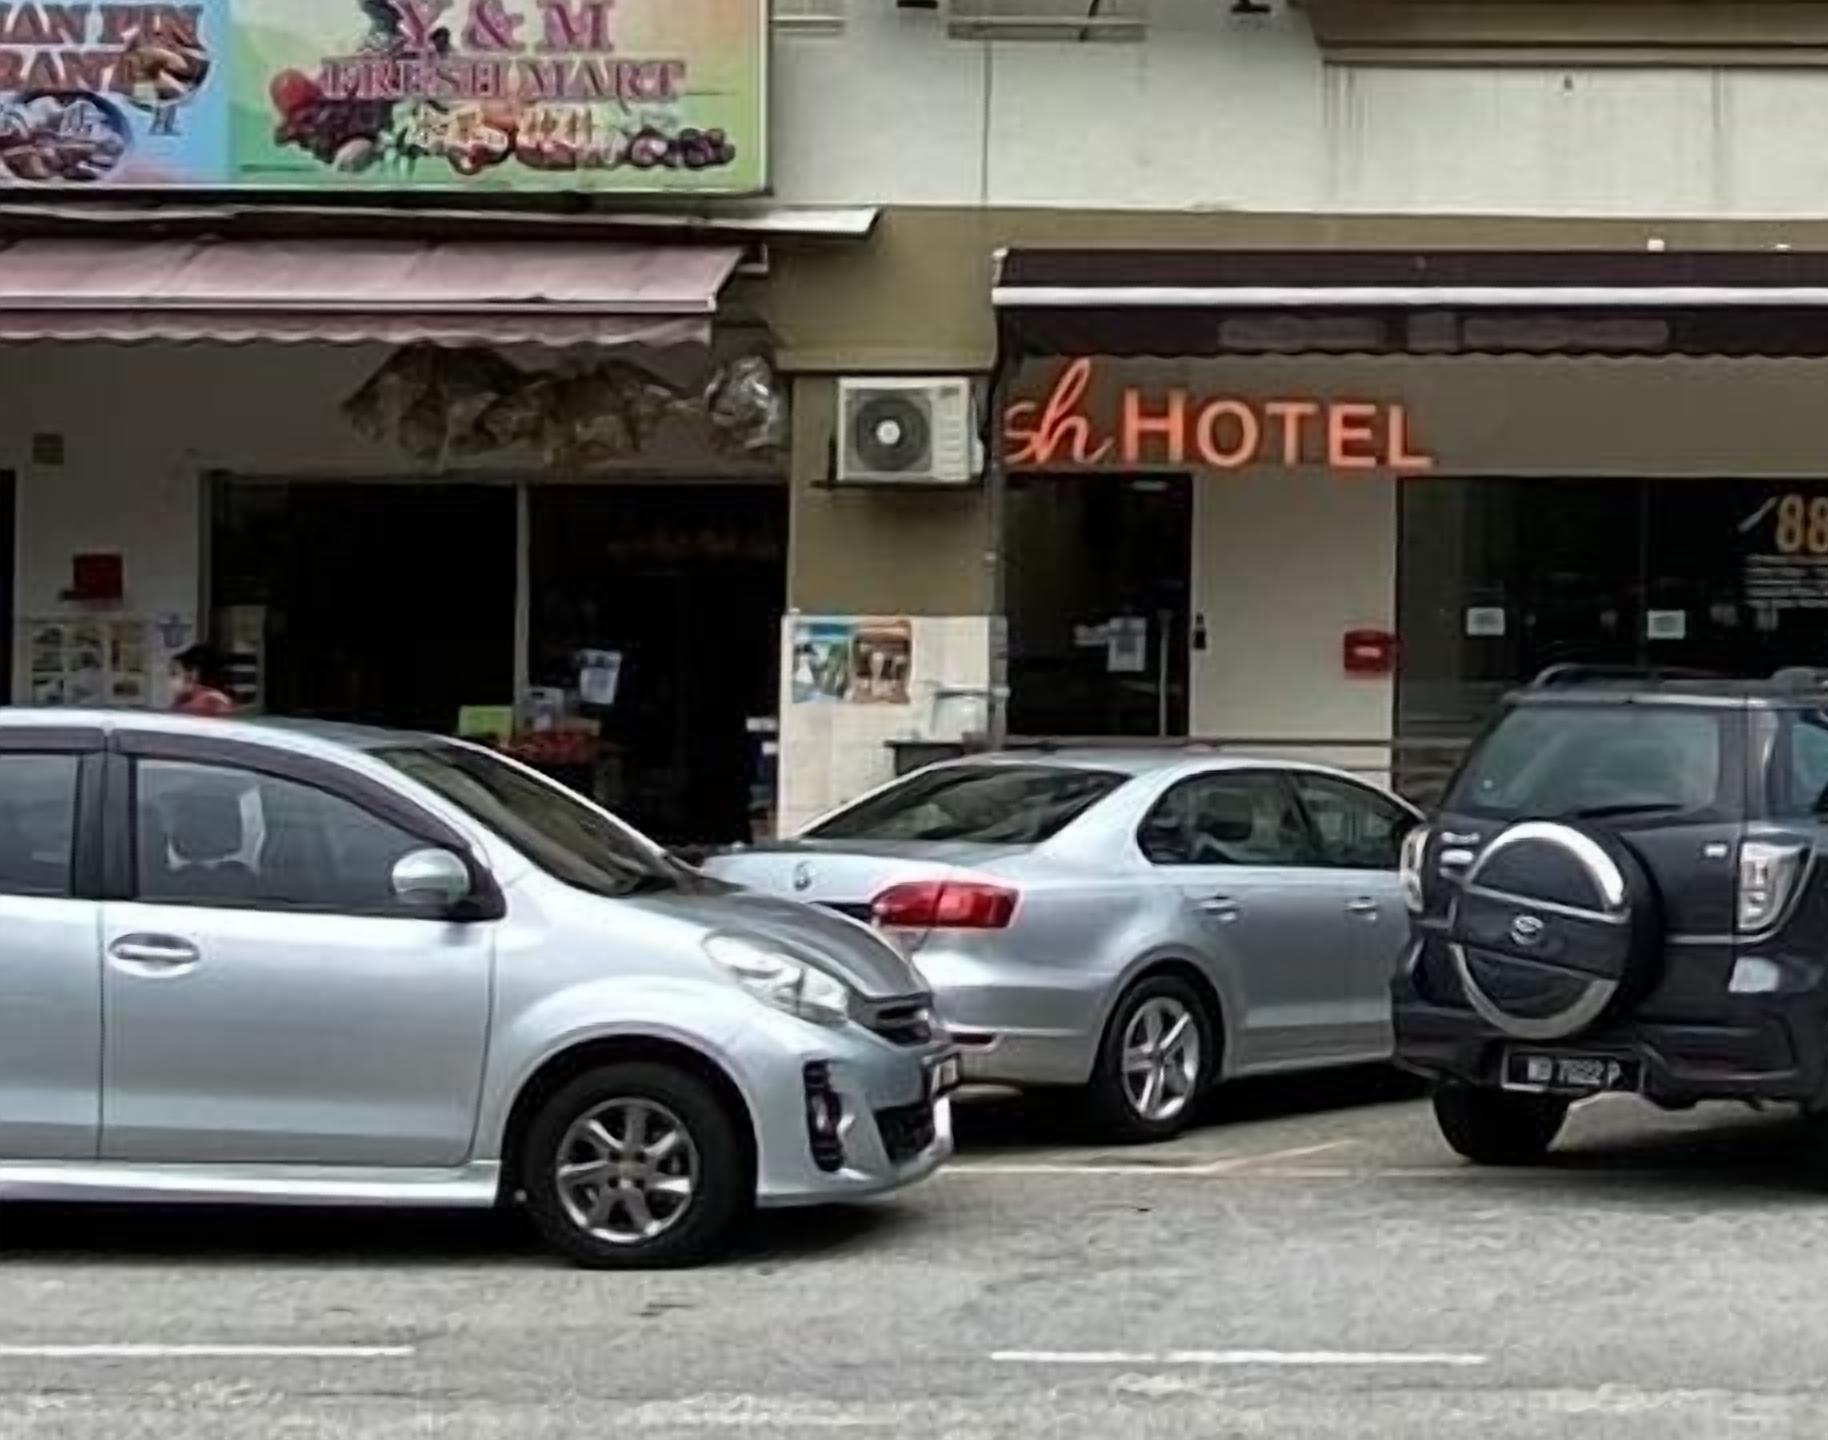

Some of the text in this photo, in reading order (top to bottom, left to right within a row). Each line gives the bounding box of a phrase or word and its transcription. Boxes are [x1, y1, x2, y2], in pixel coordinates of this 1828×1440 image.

[318, 57, 686, 104] FRESH MART
[1005, 357, 1434, 470] sh HOTEL
